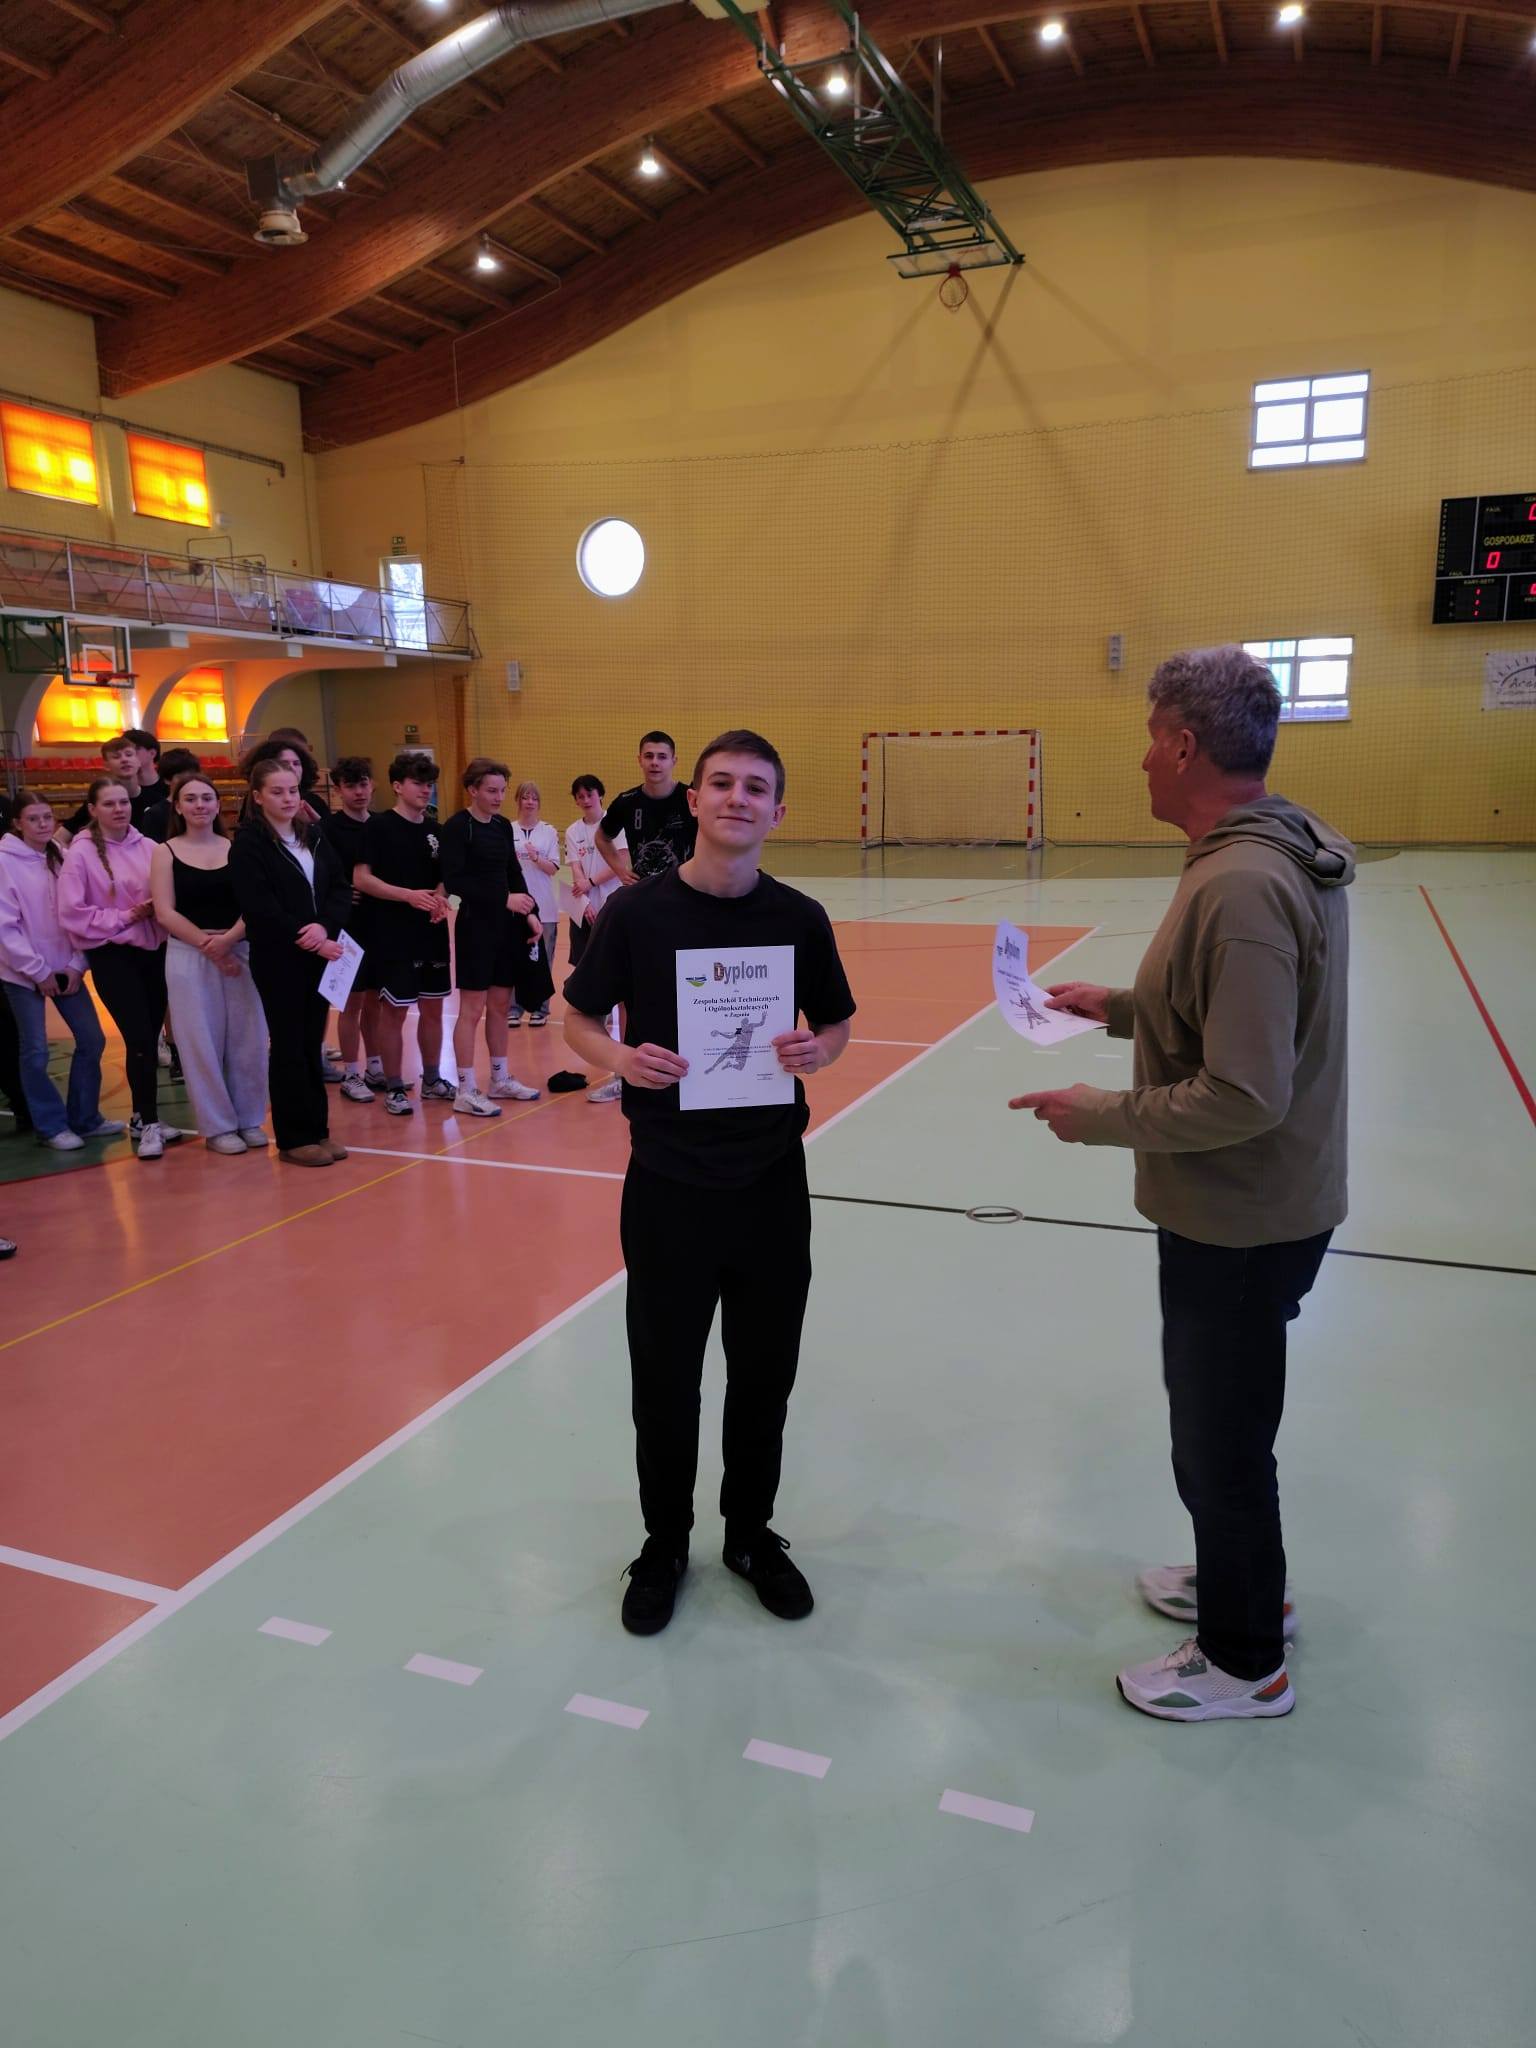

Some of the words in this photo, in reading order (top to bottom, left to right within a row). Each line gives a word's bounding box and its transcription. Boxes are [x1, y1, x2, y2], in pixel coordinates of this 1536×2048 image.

[1483, 534, 1535, 547] GOSPODARZE
[1486, 551, 1501, 569] 0
[634, 808, 643, 830] 8
[713, 961, 768, 985] Dyplom
[738, 995, 780, 1003] Technicznych
